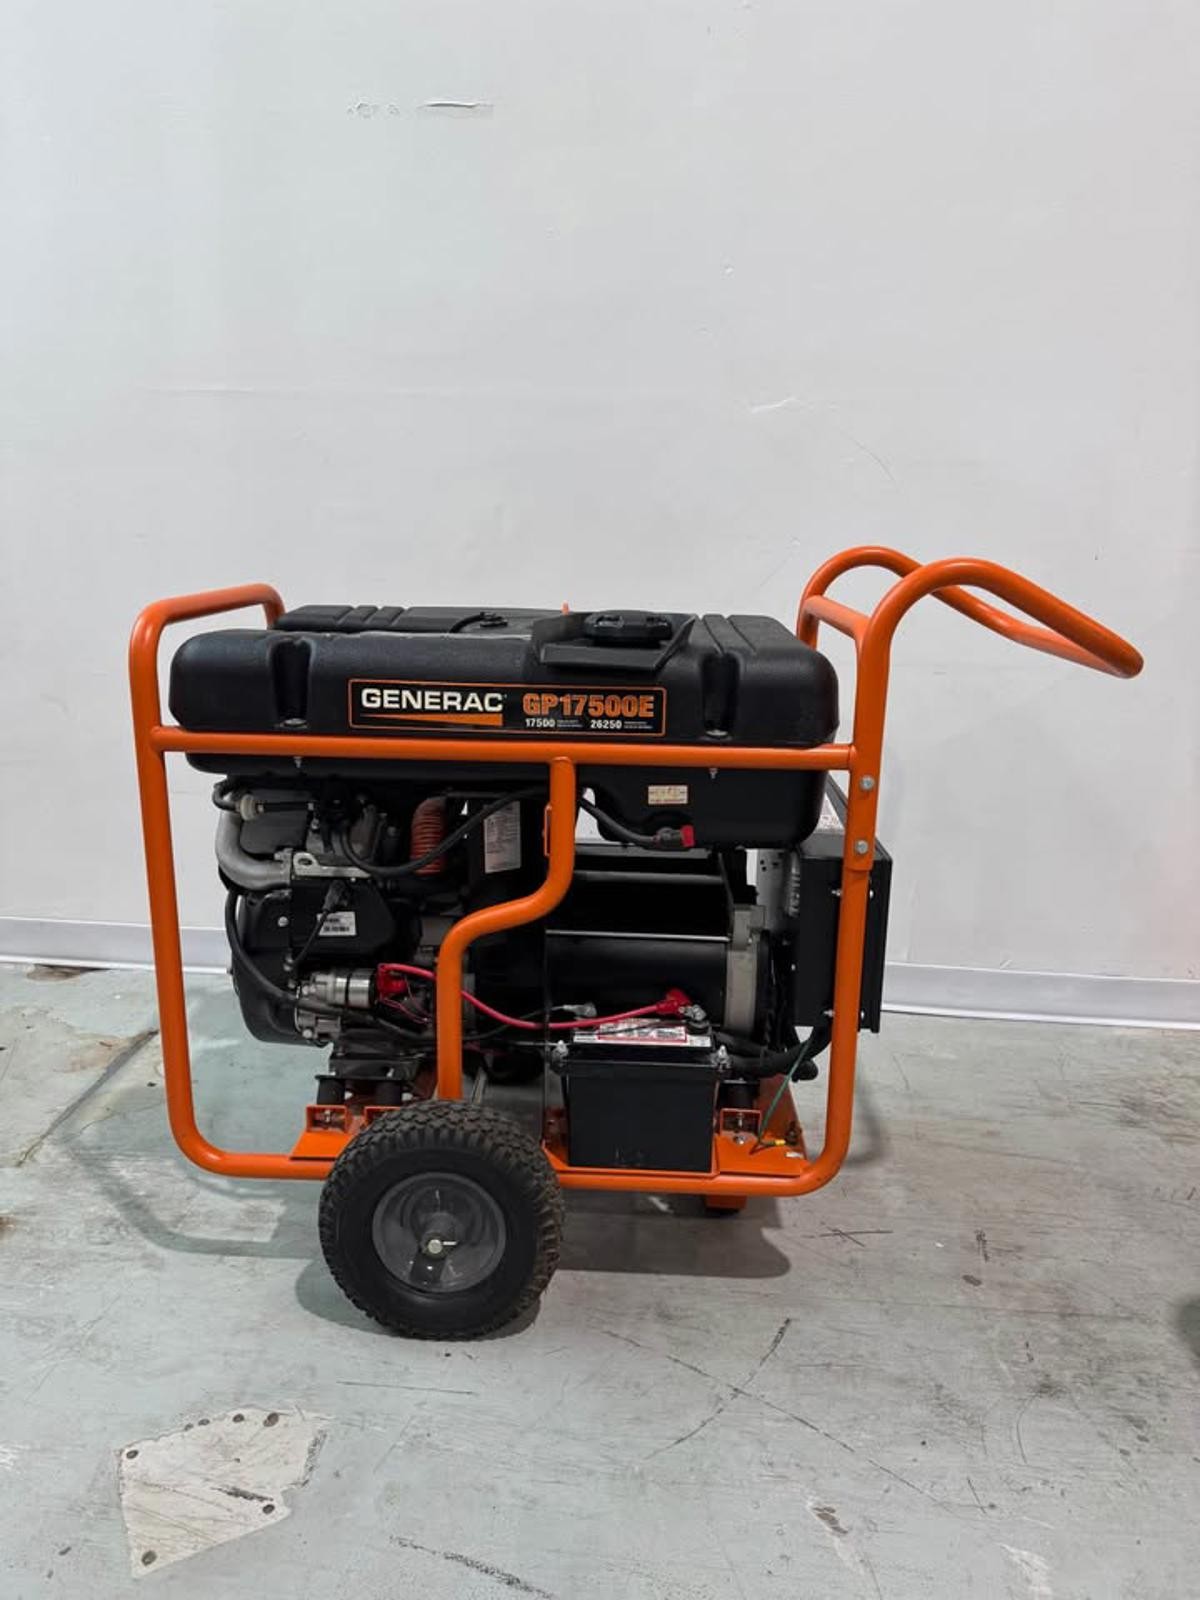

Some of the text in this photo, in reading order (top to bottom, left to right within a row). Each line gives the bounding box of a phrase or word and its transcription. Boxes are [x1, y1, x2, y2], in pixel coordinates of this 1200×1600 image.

[361, 687, 504, 712] GENERAC
[522, 692, 655, 718] GP17500E
[525, 718, 556, 728] 17500
[590, 719, 622, 729] 26250
